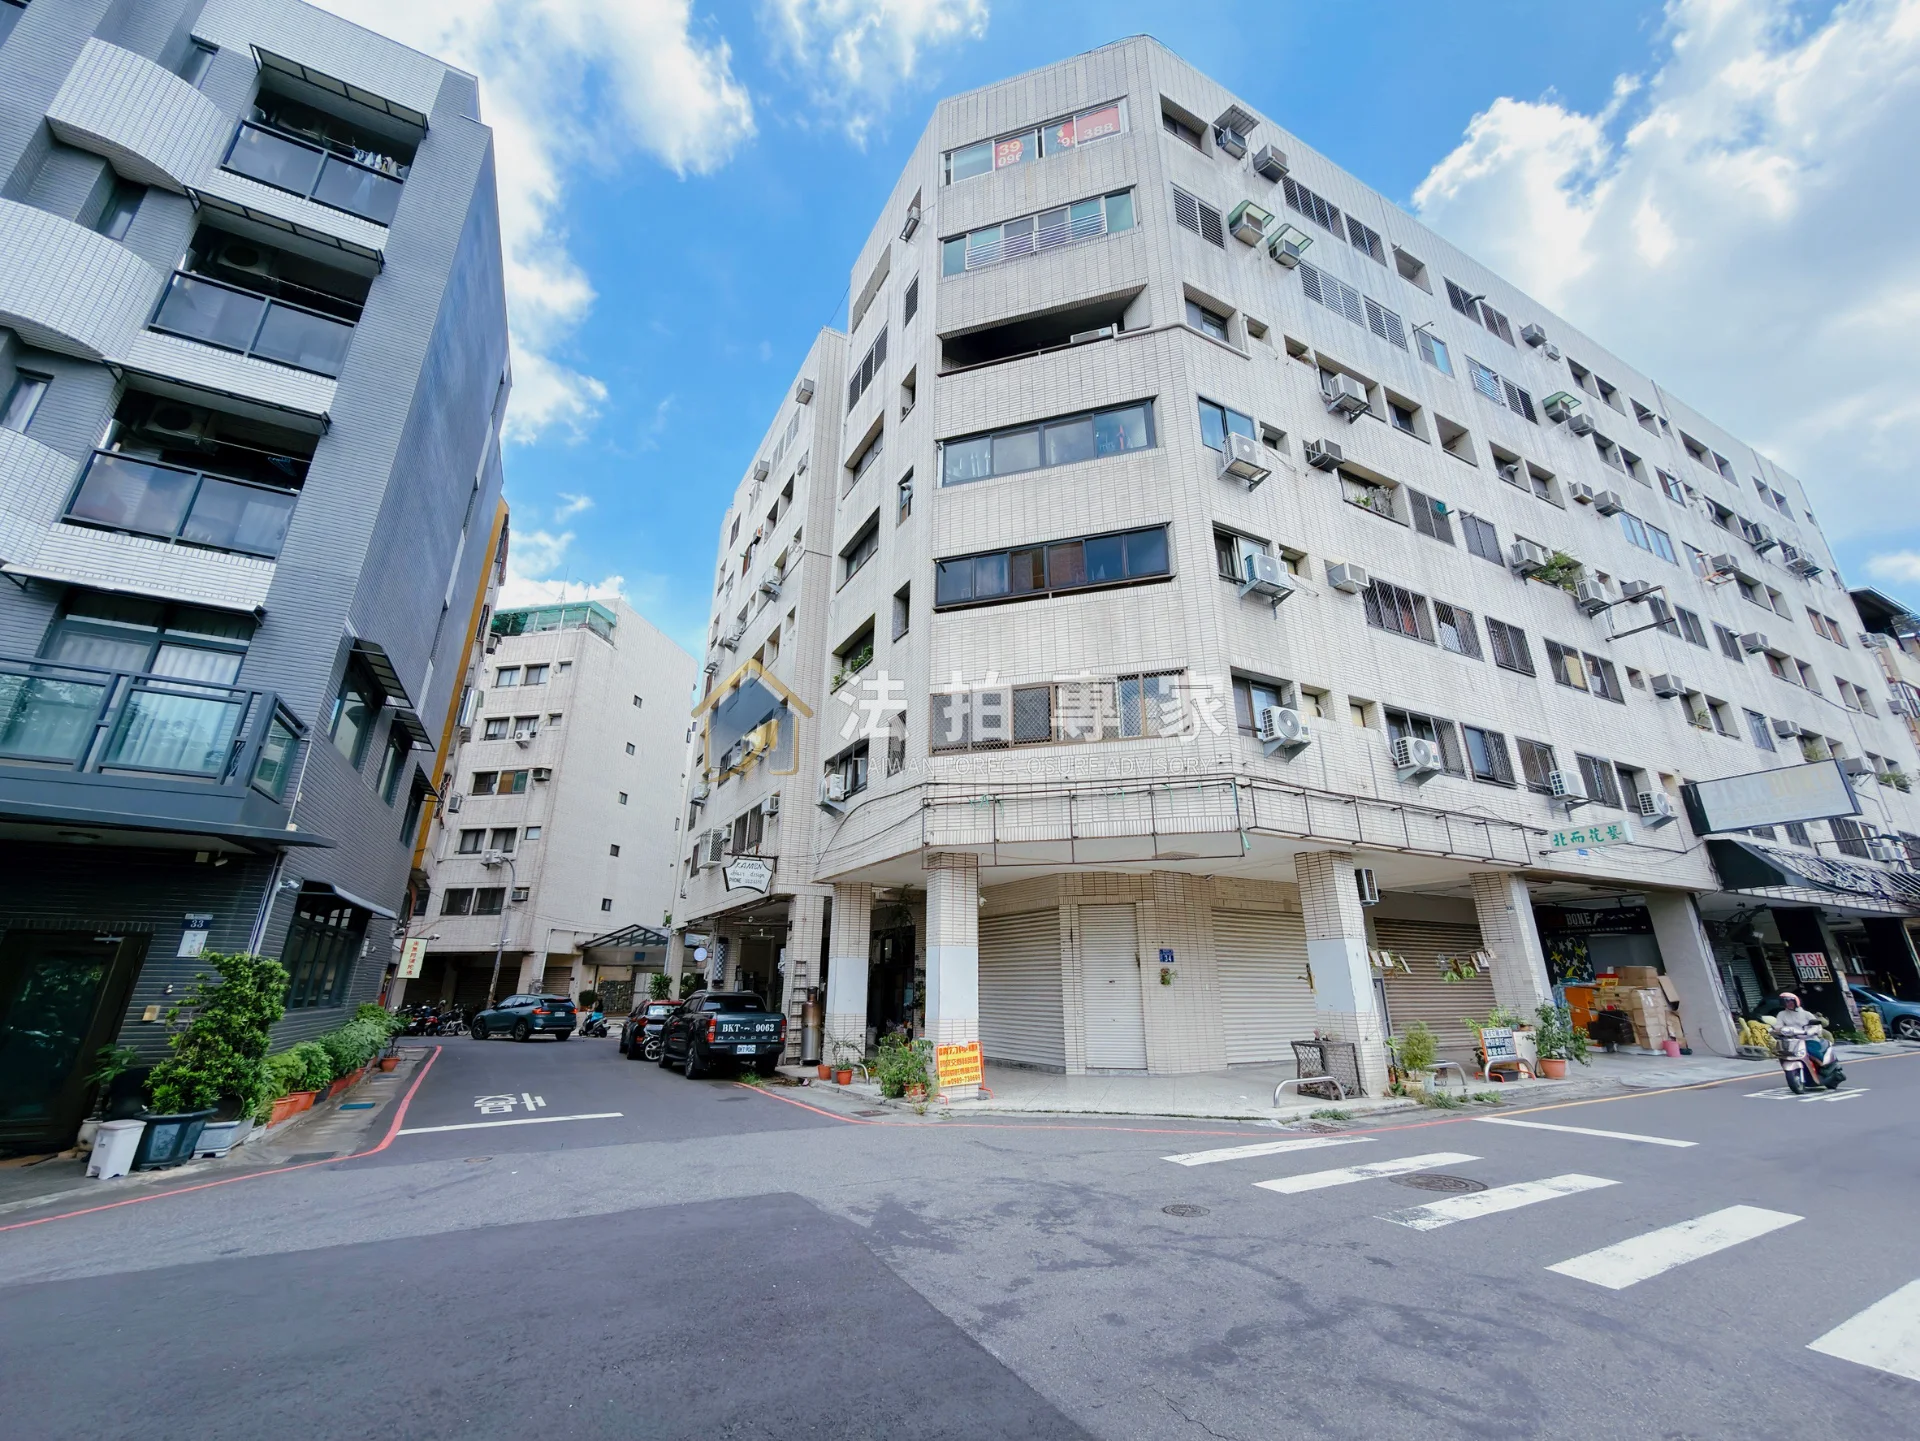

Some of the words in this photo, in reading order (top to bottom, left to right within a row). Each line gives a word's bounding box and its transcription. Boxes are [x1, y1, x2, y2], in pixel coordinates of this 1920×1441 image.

[1084, 123, 1113, 139] 388
[190, 919, 204, 928] 33
[1795, 954, 1824, 966] FISH
[1799, 967, 1829, 979] BONE
[755, 1024, 774, 1032] 9062
